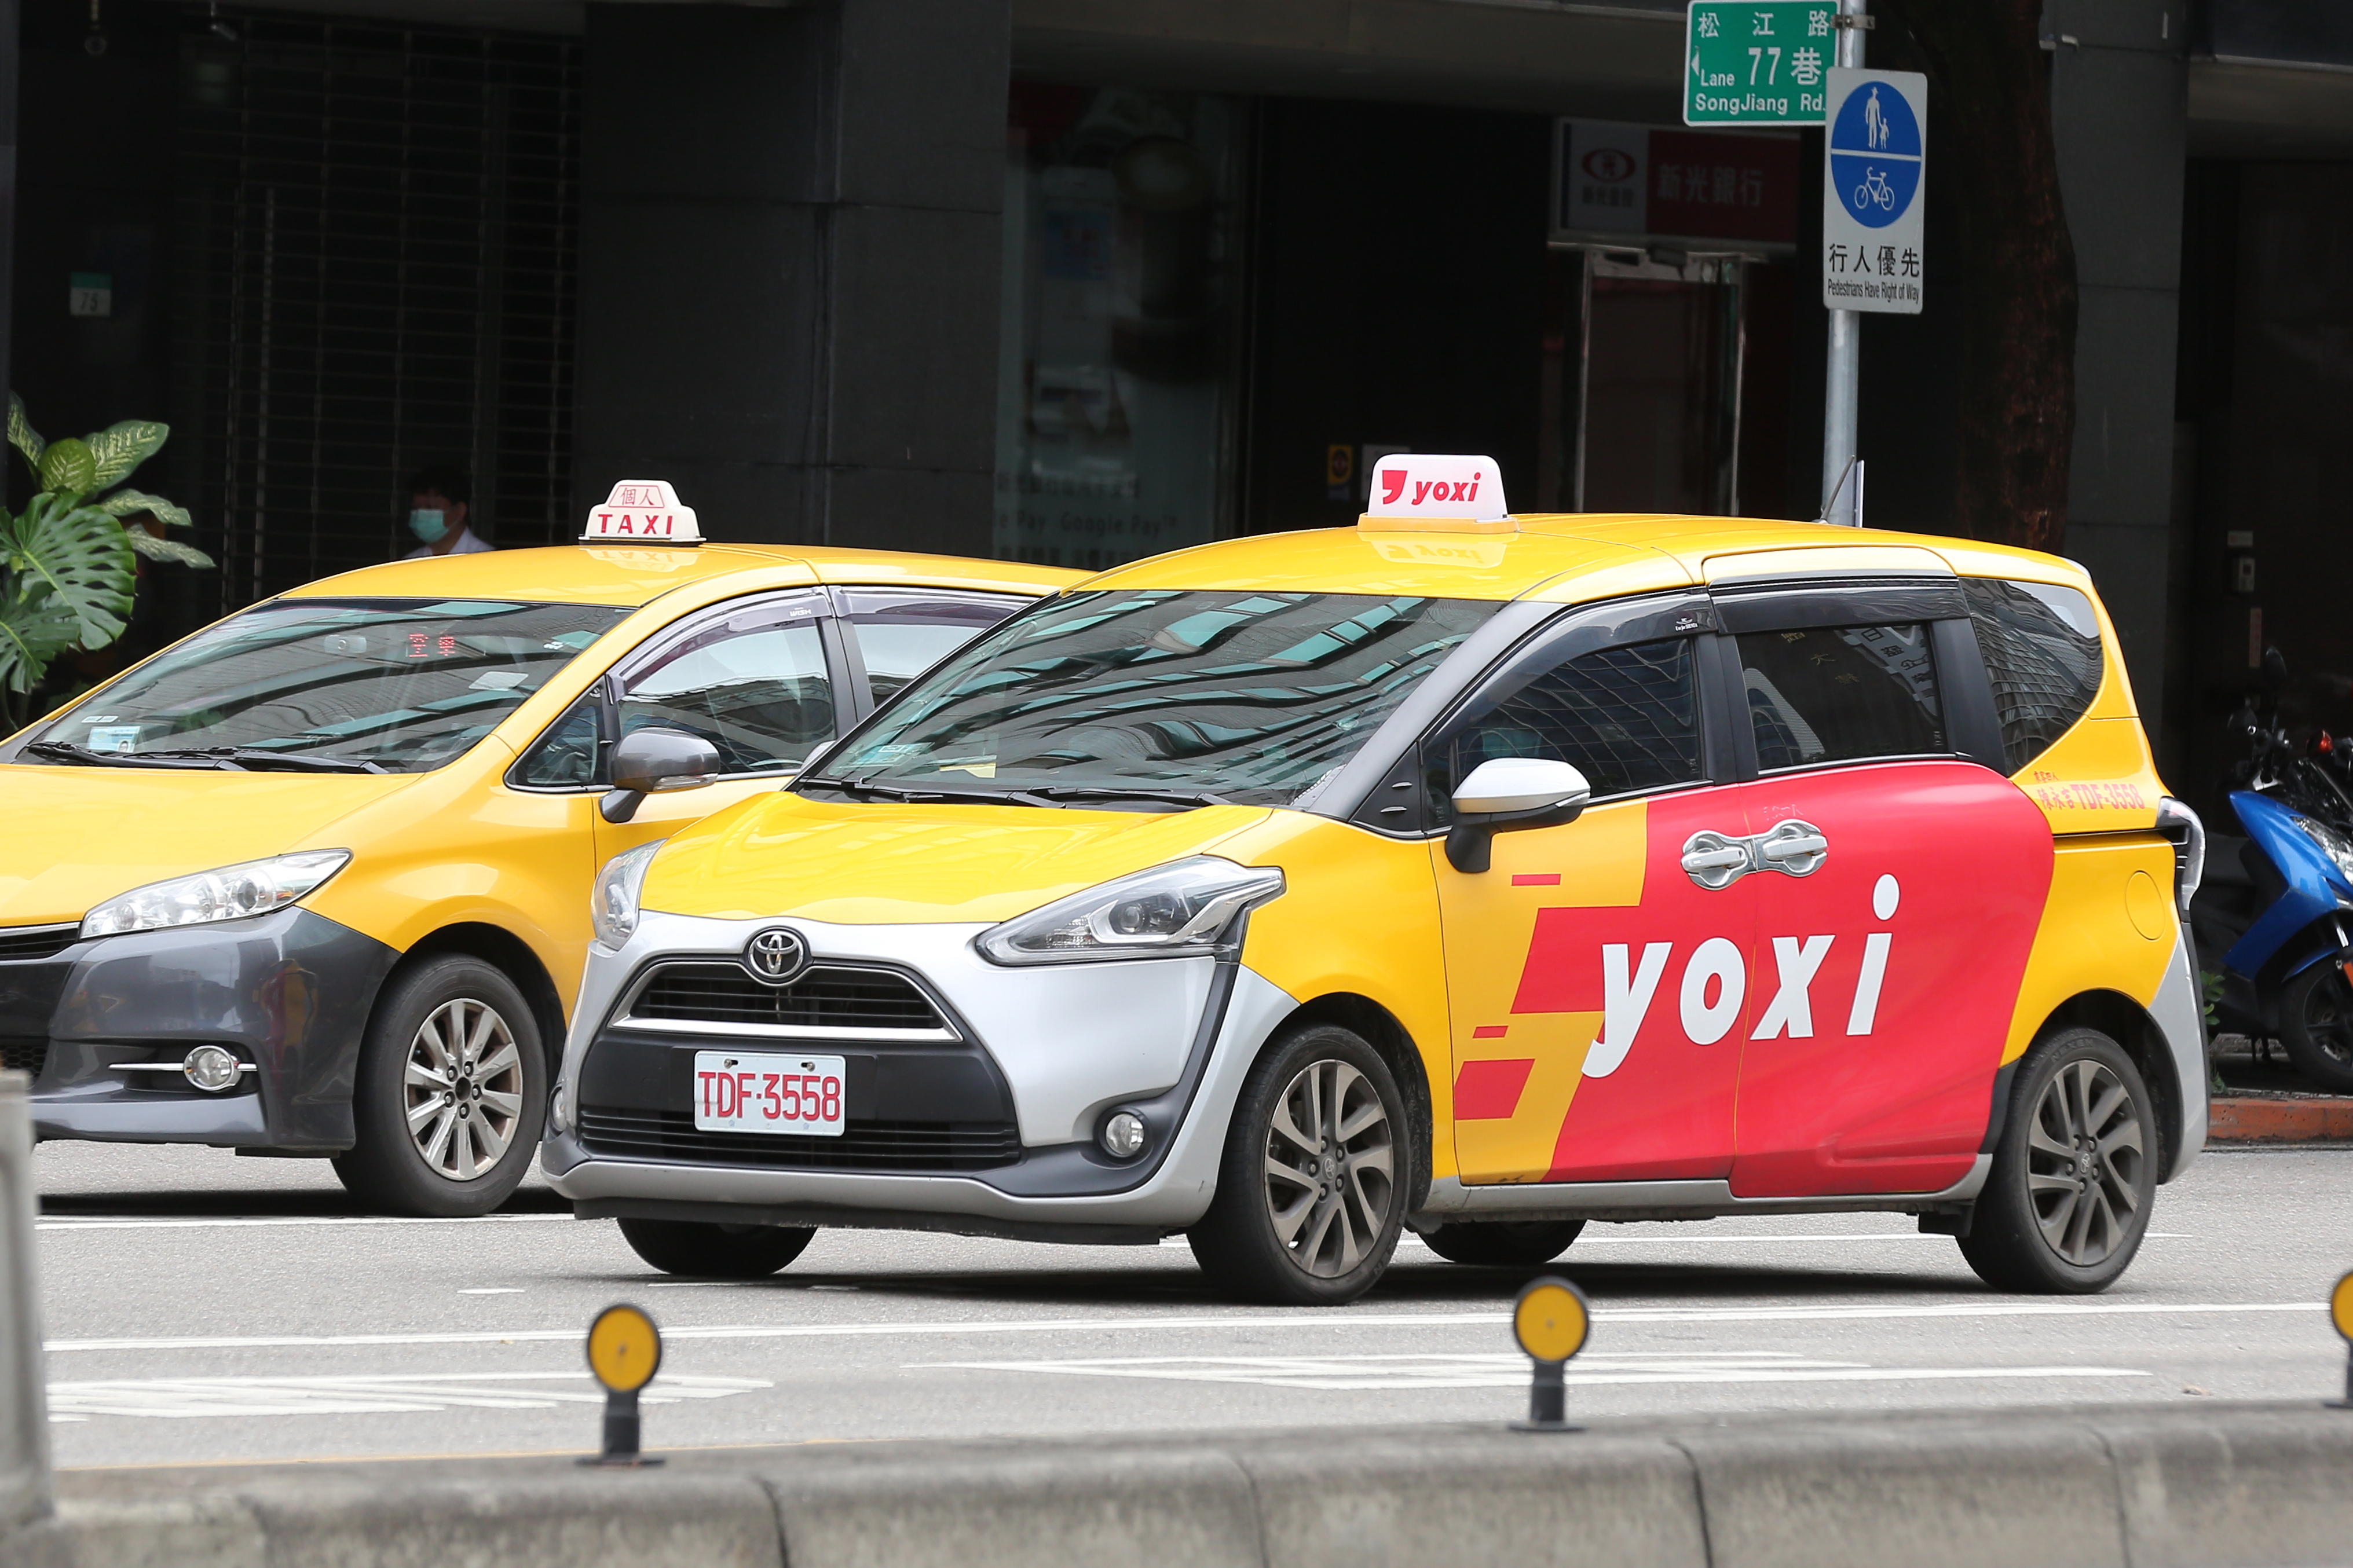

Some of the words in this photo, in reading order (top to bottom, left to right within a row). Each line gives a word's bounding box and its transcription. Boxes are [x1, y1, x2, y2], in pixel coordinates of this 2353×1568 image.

[1698, 9, 1829, 38] 松江路
[1700, 68, 1735, 86] Lane
[1696, 93, 1788, 115] SongJiang
[1657, 162, 1764, 207] 新光銀行
[1829, 243, 1920, 277] 行人優先
[80, 291, 98, 312] 75
[1828, 279, 1863, 298] Pedestrians
[1865, 280, 1880, 298] Have
[1882, 281, 1897, 303] Right
[1898, 283, 1905, 300] of
[1906, 283, 1920, 305] Way
[620, 487, 655, 506] 個人
[1411, 472, 1481, 505] yoxi
[598, 514, 674, 535] TAXI
[1060, 511, 1124, 537] Google
[789, 609, 812, 617] WISH
[2070, 783, 2145, 810] TDF-3558
[1581, 873, 1900, 1079] yoxi
